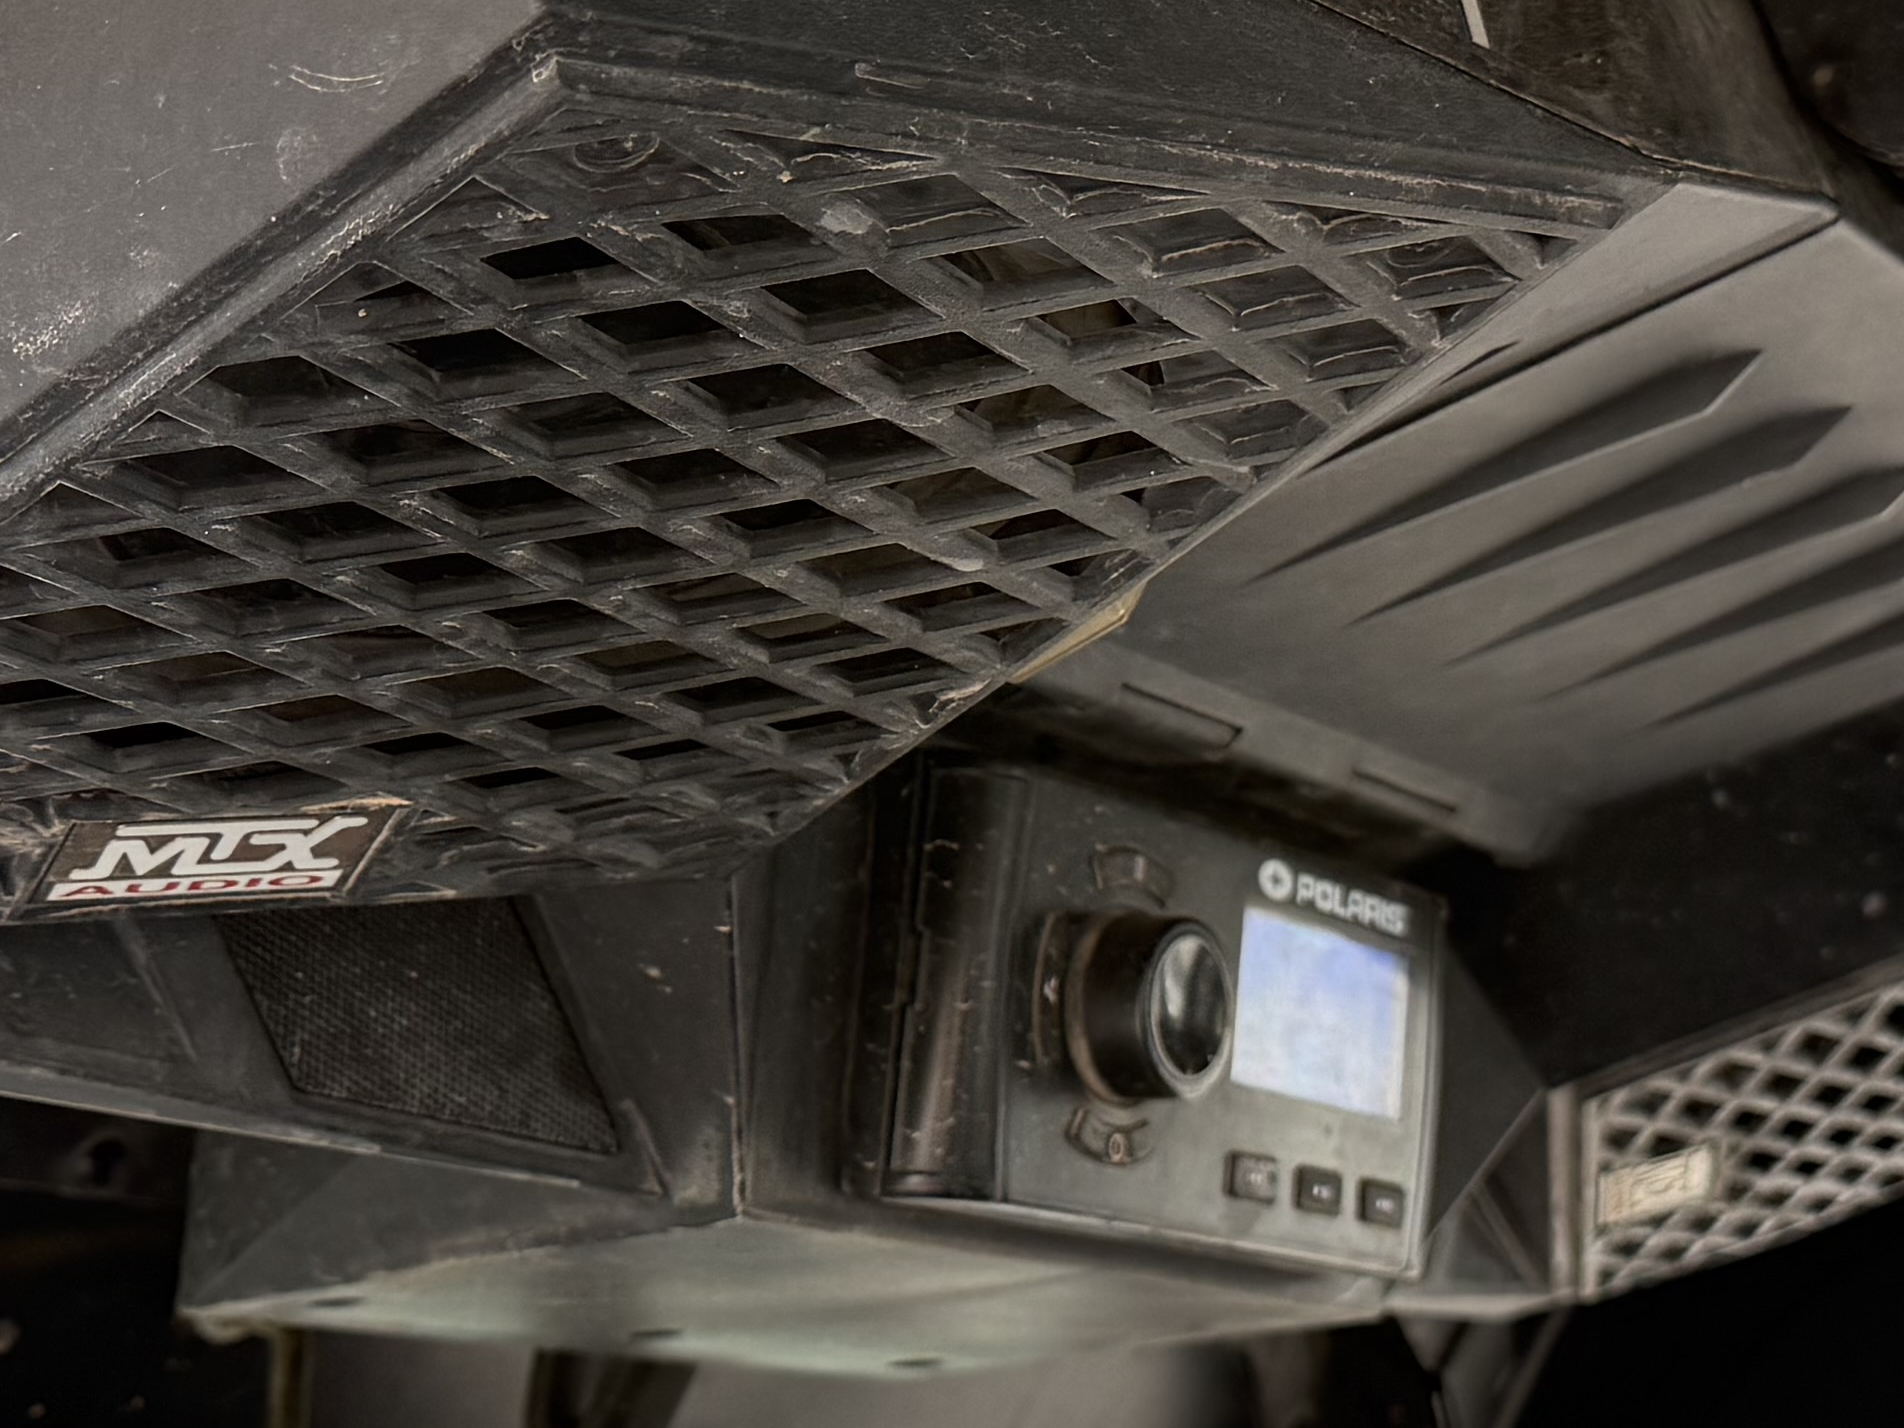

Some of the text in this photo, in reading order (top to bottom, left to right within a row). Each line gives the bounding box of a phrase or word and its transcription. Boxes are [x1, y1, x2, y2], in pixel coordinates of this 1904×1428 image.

[68, 815, 369, 881] MTX
[59, 874, 325, 899] AUDIO
[1296, 872, 1410, 937] POLARIS
